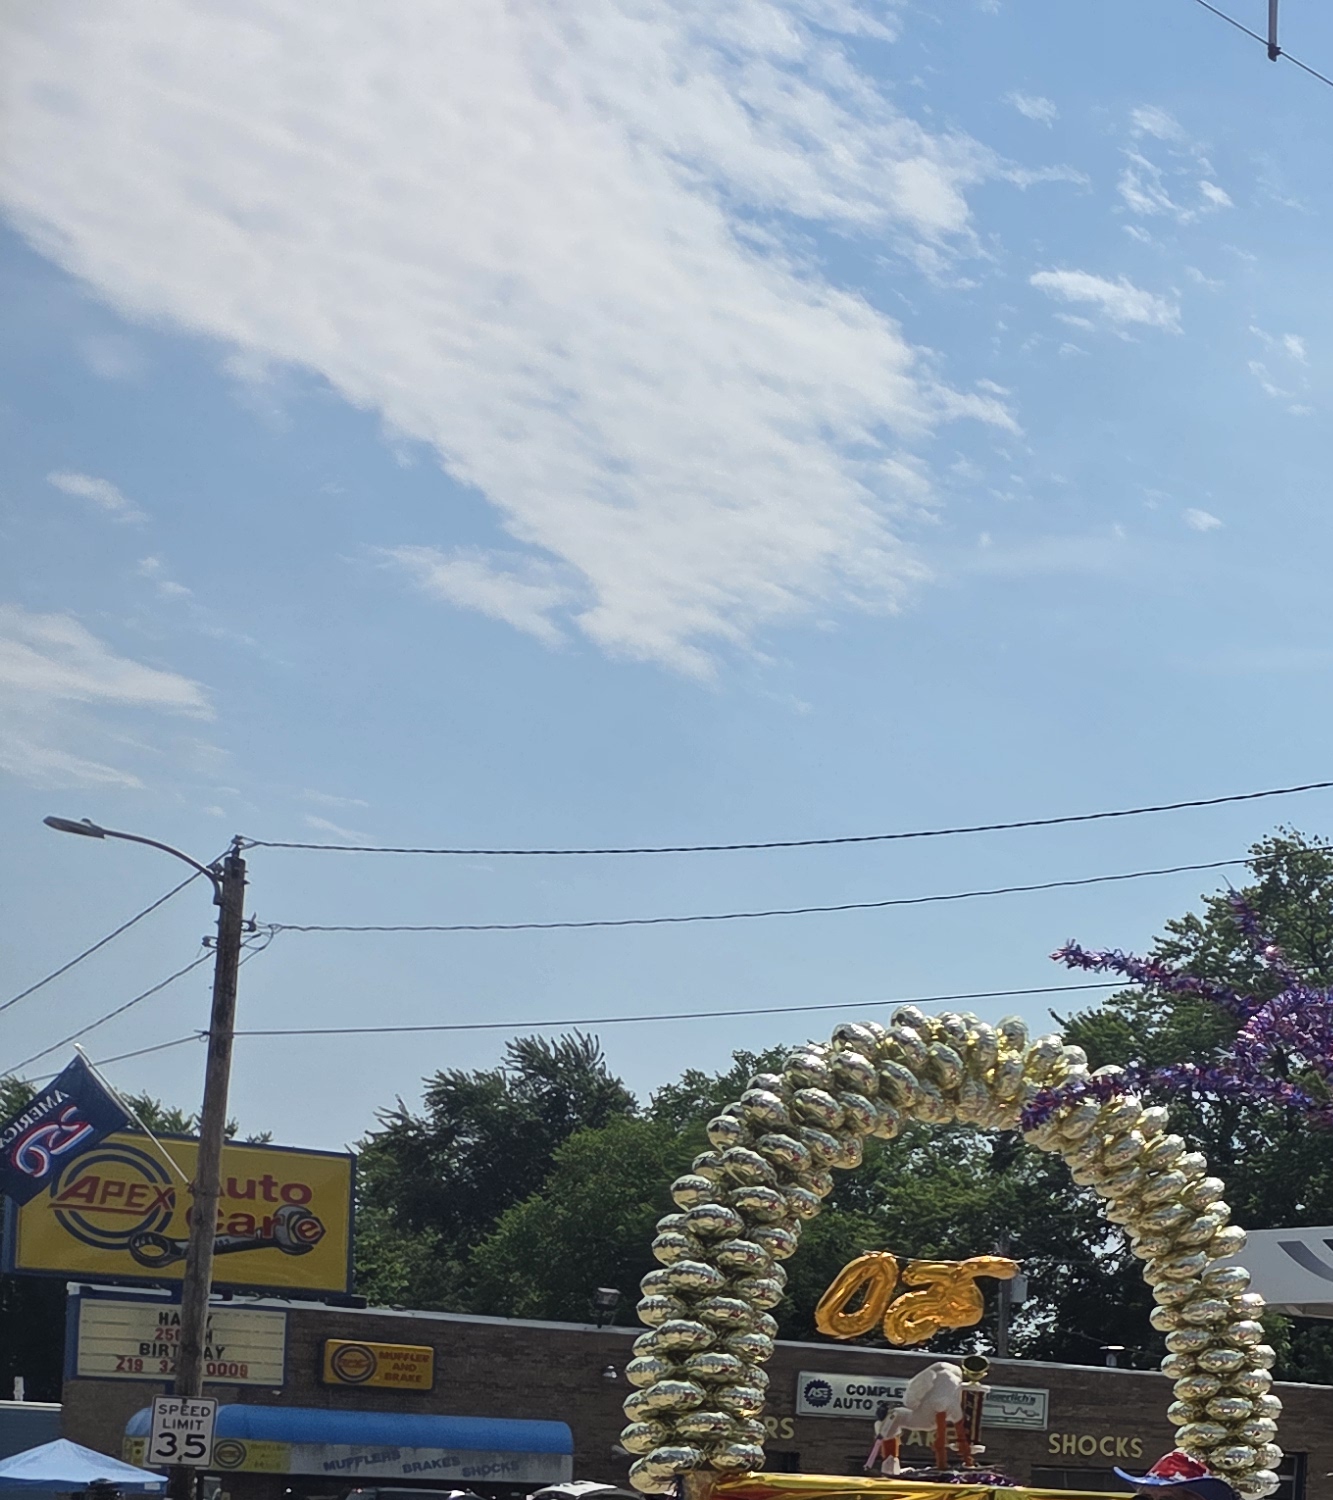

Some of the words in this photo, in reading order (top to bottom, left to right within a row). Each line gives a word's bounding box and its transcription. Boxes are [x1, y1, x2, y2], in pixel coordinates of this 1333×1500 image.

[50, 1175, 175, 1212] APEX
[139, 1342, 226, 1360] BIRTAY
[808, 1386, 830, 1398] ASE
[158, 1404, 211, 1417] SPEED
[833, 1398, 873, 1410] AUTO
[162, 1418, 204, 1431] LIMIT
[155, 1431, 206, 1459] 35
[1048, 1432, 1144, 1459] SHOCKS
[323, 1448, 401, 1471] MUFFLERS
[402, 1456, 461, 1474] BRAKES
[461, 1460, 520, 1478] SHOCKS
